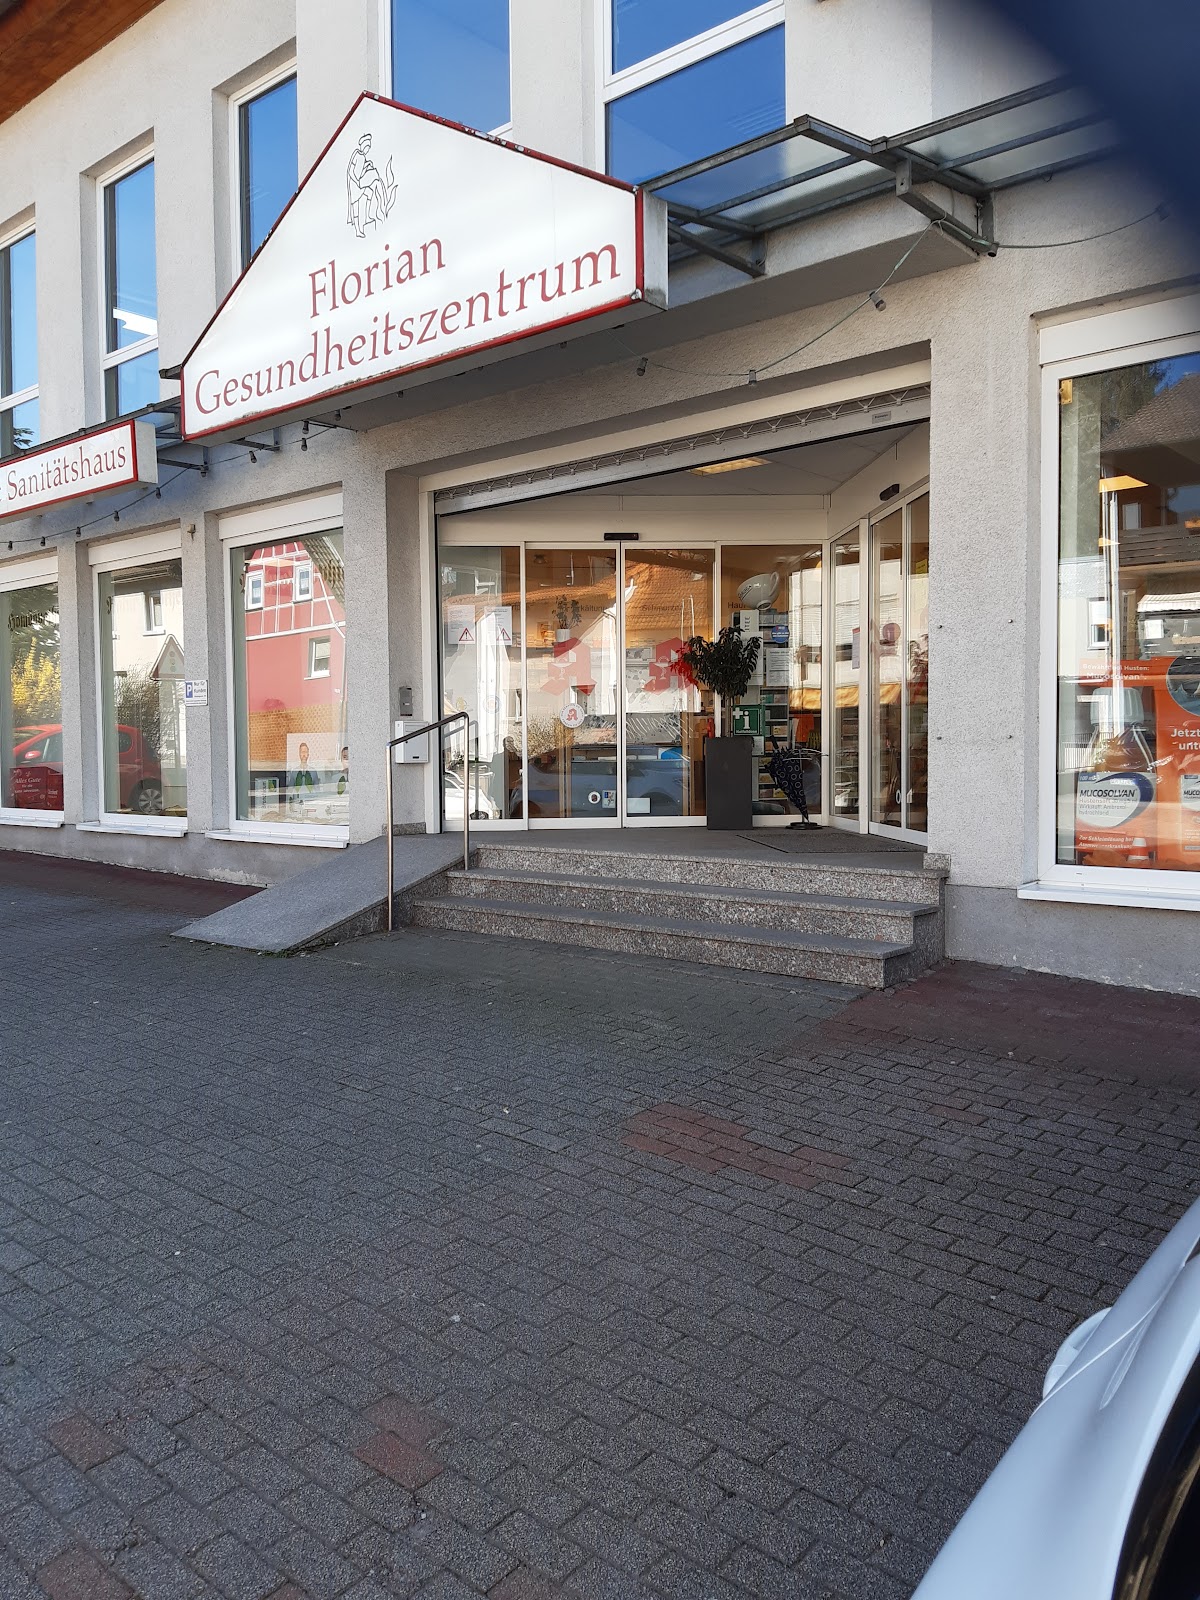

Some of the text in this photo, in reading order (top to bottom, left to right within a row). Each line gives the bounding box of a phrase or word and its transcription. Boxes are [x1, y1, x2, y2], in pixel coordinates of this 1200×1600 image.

[309, 238, 446, 318] Florian
[195, 243, 621, 414] Gesundheitszentrum
[7, 445, 126, 501] Sanitätshaus
[1170, 728, 1200, 738] Jetzt
[1178, 742, 1200, 751] unt
